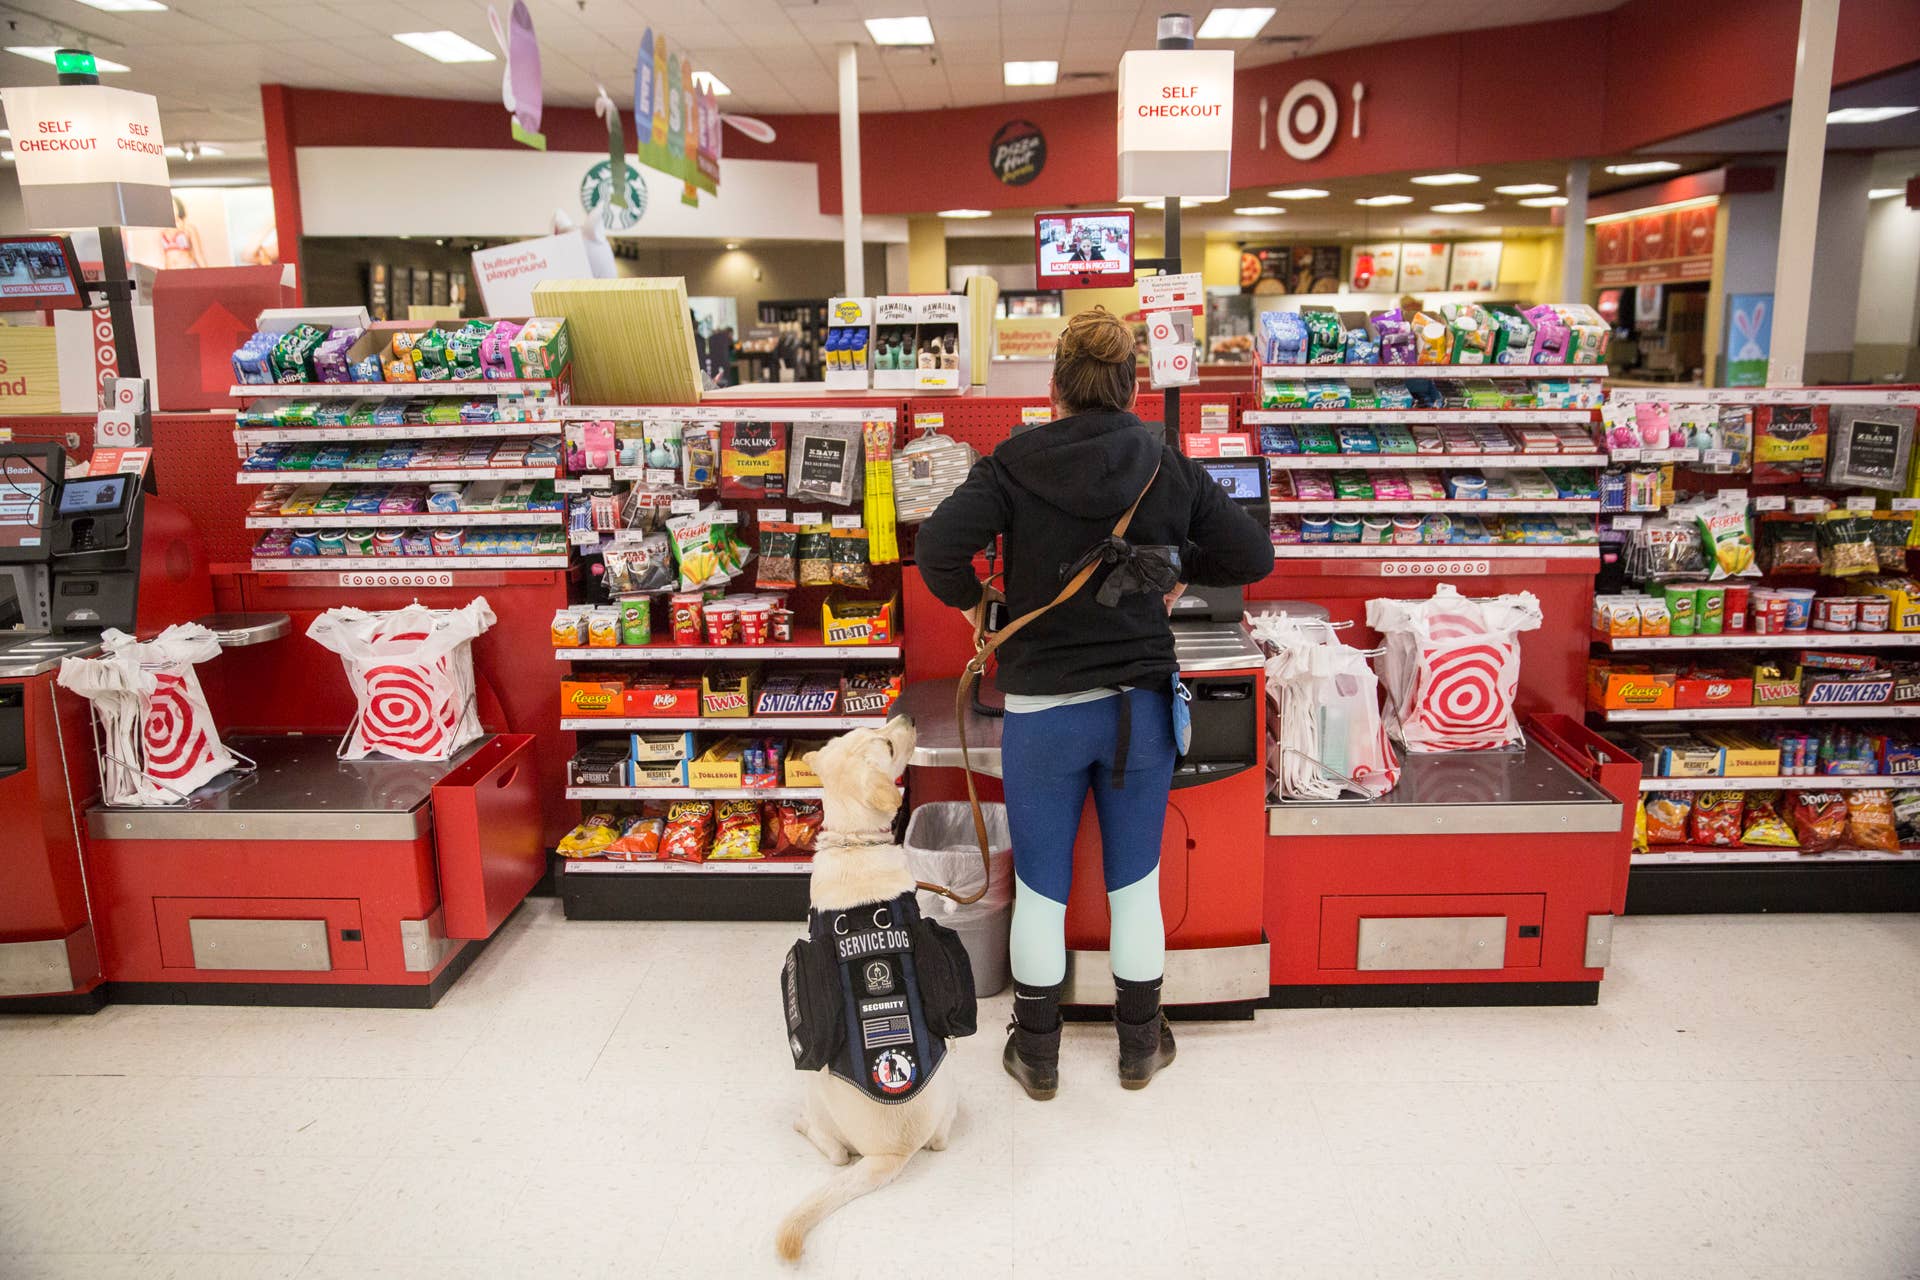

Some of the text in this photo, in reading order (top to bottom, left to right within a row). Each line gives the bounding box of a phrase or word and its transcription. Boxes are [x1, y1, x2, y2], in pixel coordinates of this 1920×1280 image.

[1162, 86, 1198, 99] SELF
[1138, 105, 1222, 117] CHECKOUT
[38, 120, 72, 133] SELF
[128, 122, 150, 137] SELF
[19, 138, 97, 152] CHECKOUT
[117, 138, 163, 156] CHECKOUT
[879, 302, 913, 314] HAWAIIAN
[922, 302, 956, 314] HAWAIIAN
[1310, 351, 1344, 365] eclipse
[278, 372, 306, 384] eclipse
[731, 438, 751, 446] JACK
[1704, 511, 1745, 529] Veggie
[672, 521, 711, 542] Veggie
[1811, 682, 1891, 702] SNICKERS
[759, 691, 836, 712] SNICKERS
[1735, 759, 1776, 767] TOBLERONE
[699, 772, 738, 780] TOBLERONE
[1800, 793, 1843, 806] Doritos
[668, 801, 710, 821] Cheetos
[839, 930, 910, 957] SERVICE DOG
[787, 953, 798, 1021] DO NOT PET
[862, 1000, 904, 1012] SECURITY
